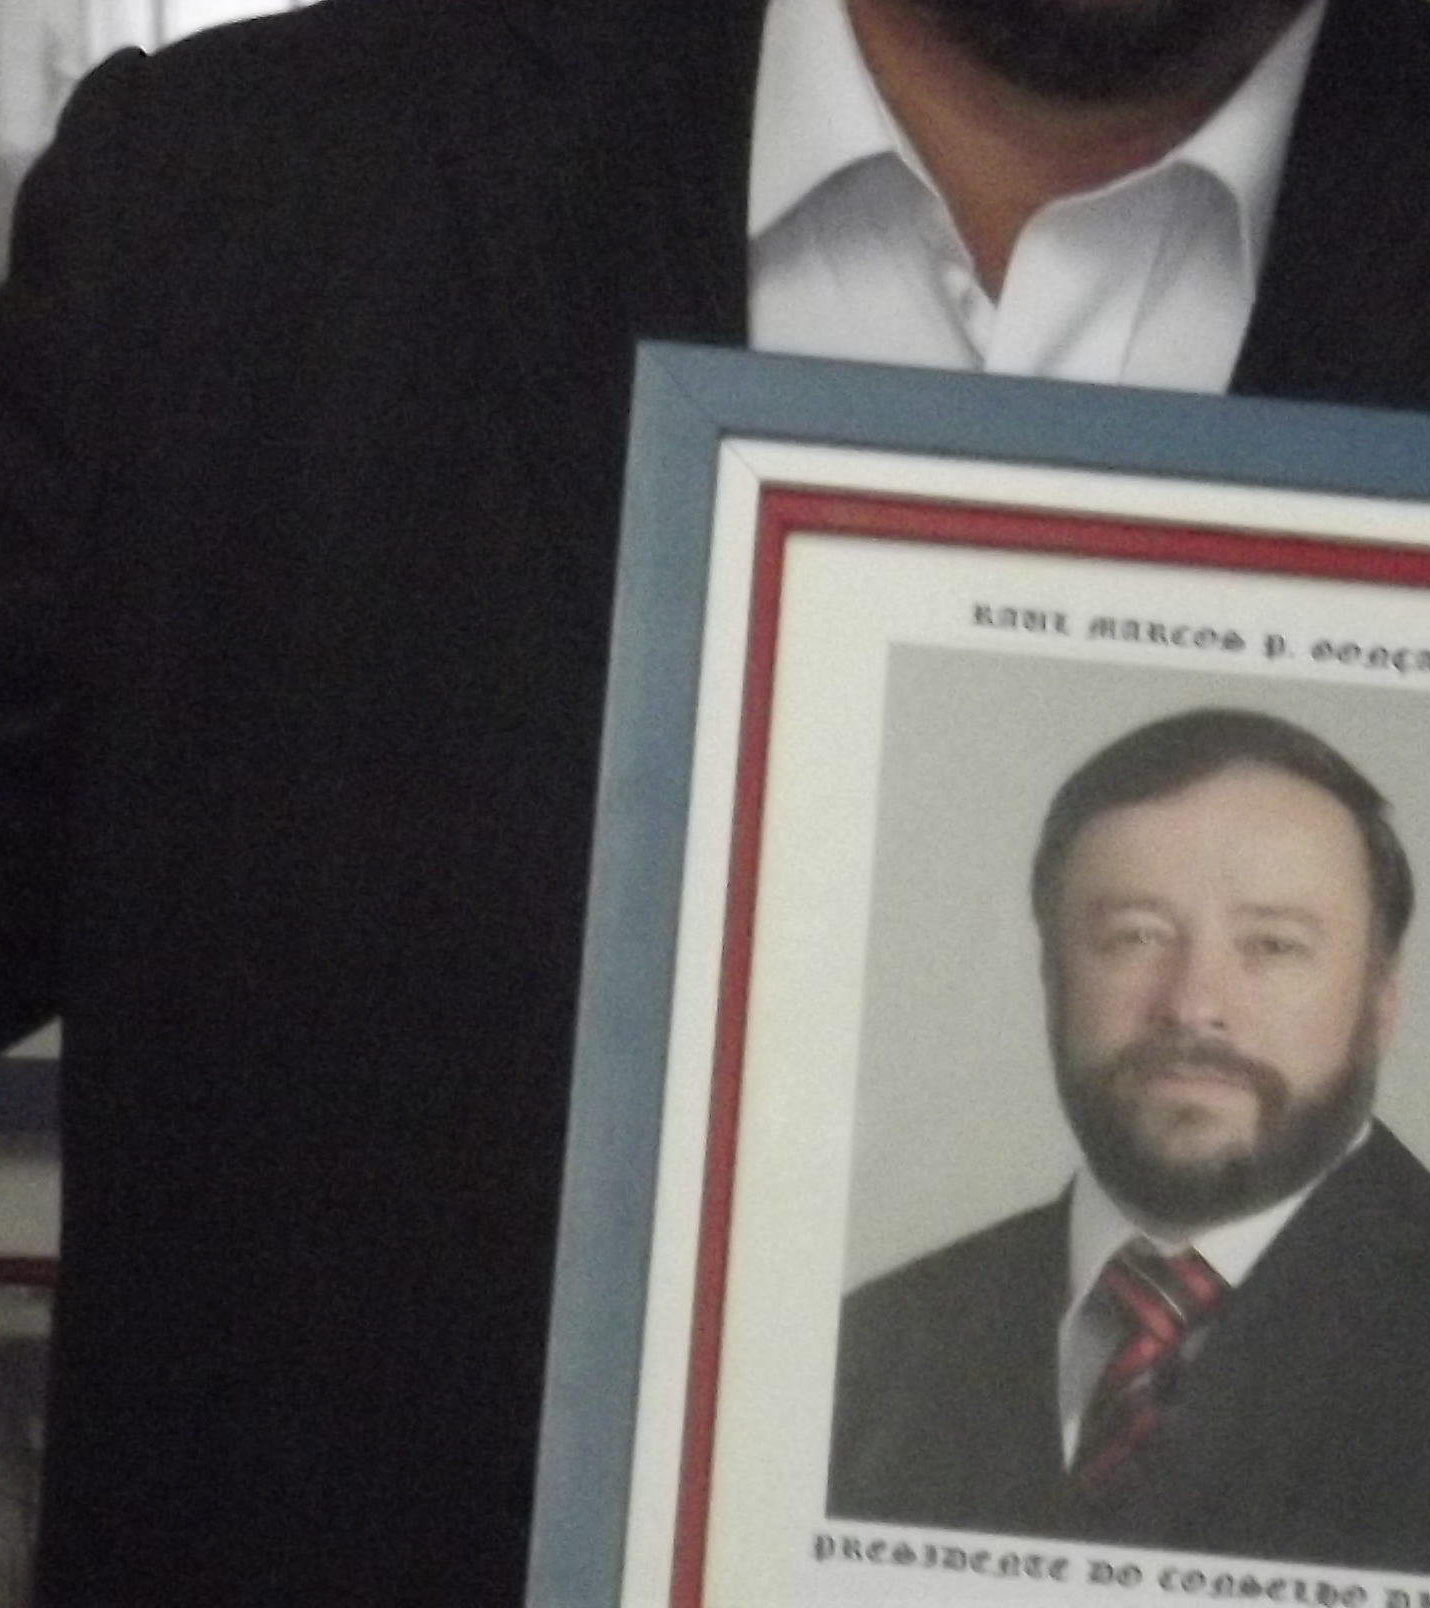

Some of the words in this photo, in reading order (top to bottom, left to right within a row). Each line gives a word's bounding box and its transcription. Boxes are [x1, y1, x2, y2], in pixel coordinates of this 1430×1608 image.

[972, 603, 1069, 635] RAUL
[1086, 615, 1246, 652] MARCOS
[814, 1533, 1069, 1583] PRESIDENTE
[1085, 1559, 1144, 1588] DO
[1156, 1567, 1369, 1608] CONSELHO
